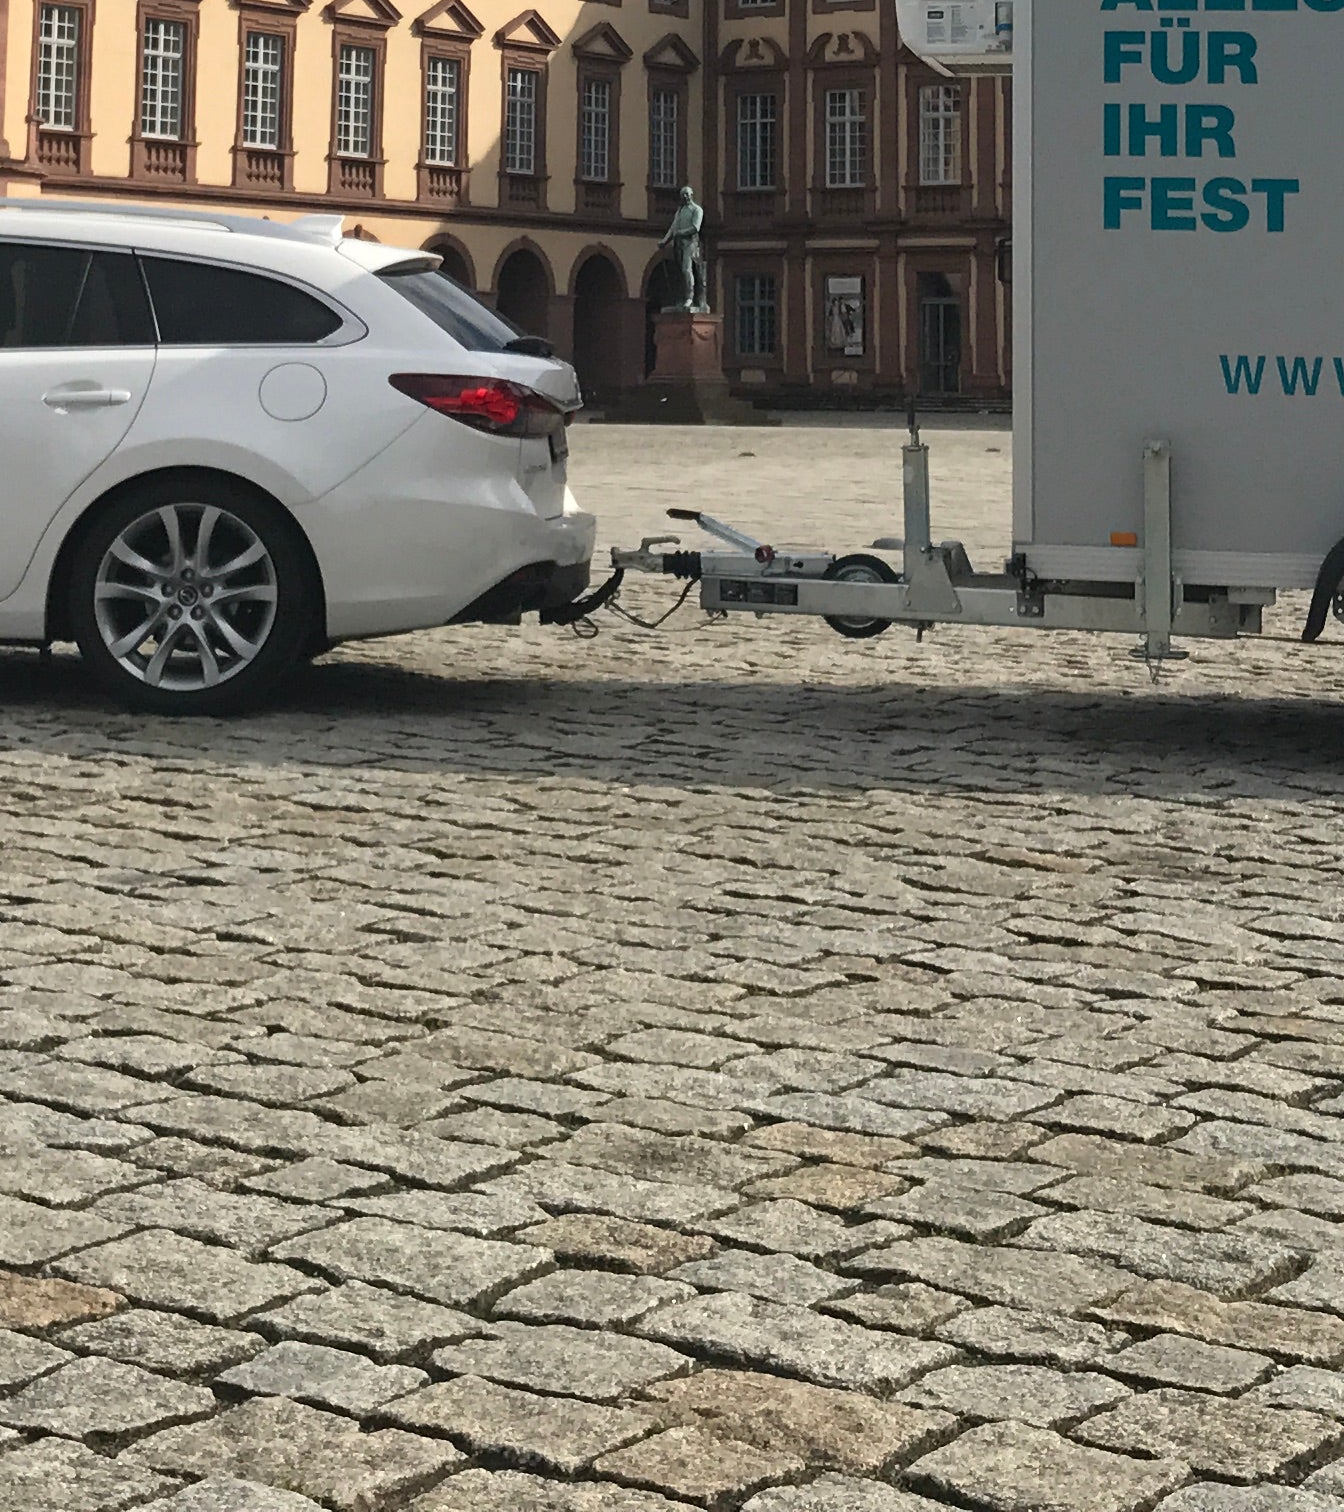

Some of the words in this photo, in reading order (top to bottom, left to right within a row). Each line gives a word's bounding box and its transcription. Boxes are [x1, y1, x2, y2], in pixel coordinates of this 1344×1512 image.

[1103, 17, 1258, 85] FÜR
[1103, 103, 1236, 158] IHR
[1103, 177, 1300, 233] FEST
